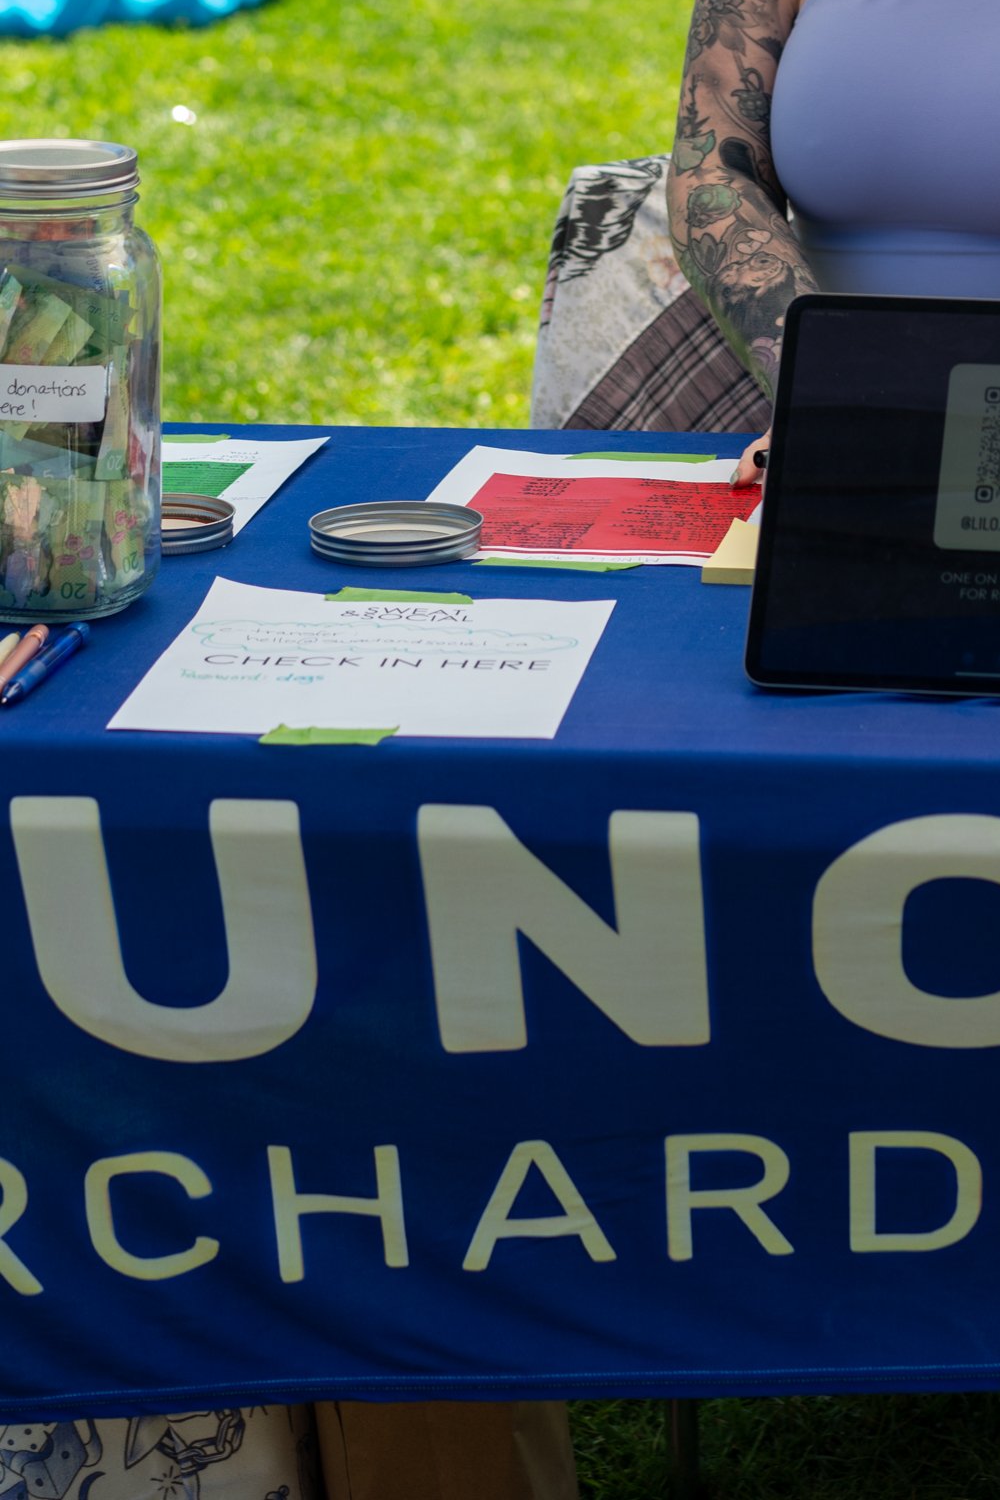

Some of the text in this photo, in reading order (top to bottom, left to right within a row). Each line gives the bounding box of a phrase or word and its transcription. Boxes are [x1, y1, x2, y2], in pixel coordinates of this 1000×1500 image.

[7, 378, 87, 398] donations
[940, 572, 970, 585] ONE
[974, 573, 998, 586] ON
[60, 582, 87, 600] 20
[959, 587, 987, 601] FOR
[361, 613, 474, 623] SOCIAL
[367, 606, 466, 616] SWEAT
[203, 654, 552, 671] CHECK IN HERE
